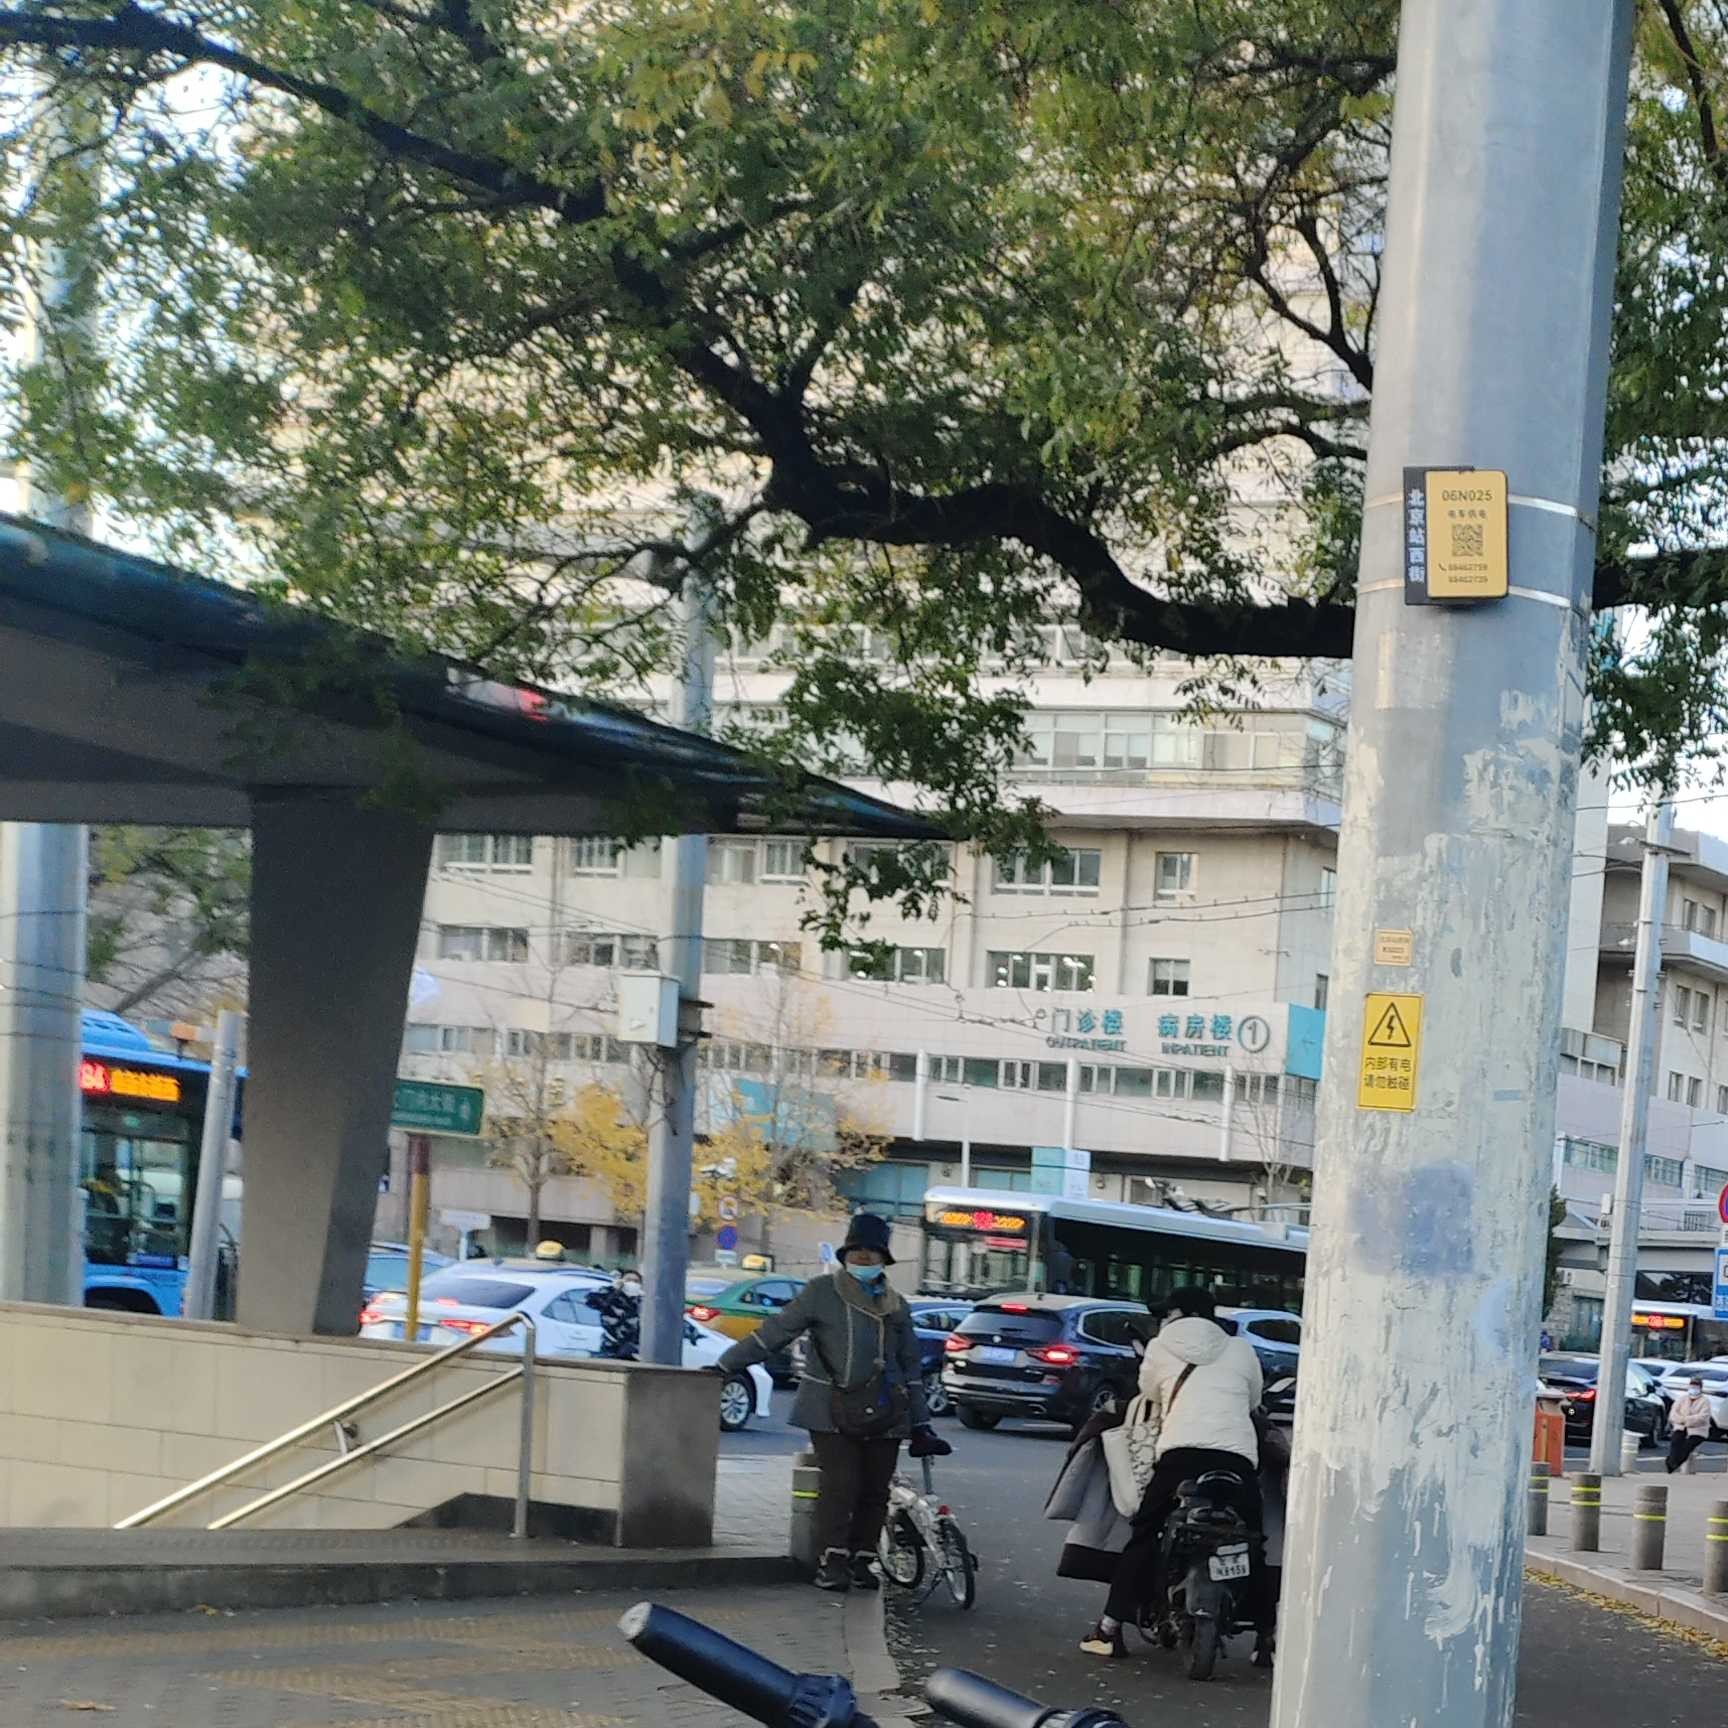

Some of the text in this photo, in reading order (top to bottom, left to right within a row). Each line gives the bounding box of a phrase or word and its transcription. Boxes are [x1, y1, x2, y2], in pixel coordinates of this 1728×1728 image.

[1408, 488, 1425, 584] 北京站西街
[1052, 1006, 1124, 1036] 门诊楼
[1157, 1012, 1233, 1041] 病房楼
[1364, 1056, 1412, 1072] 内部有电
